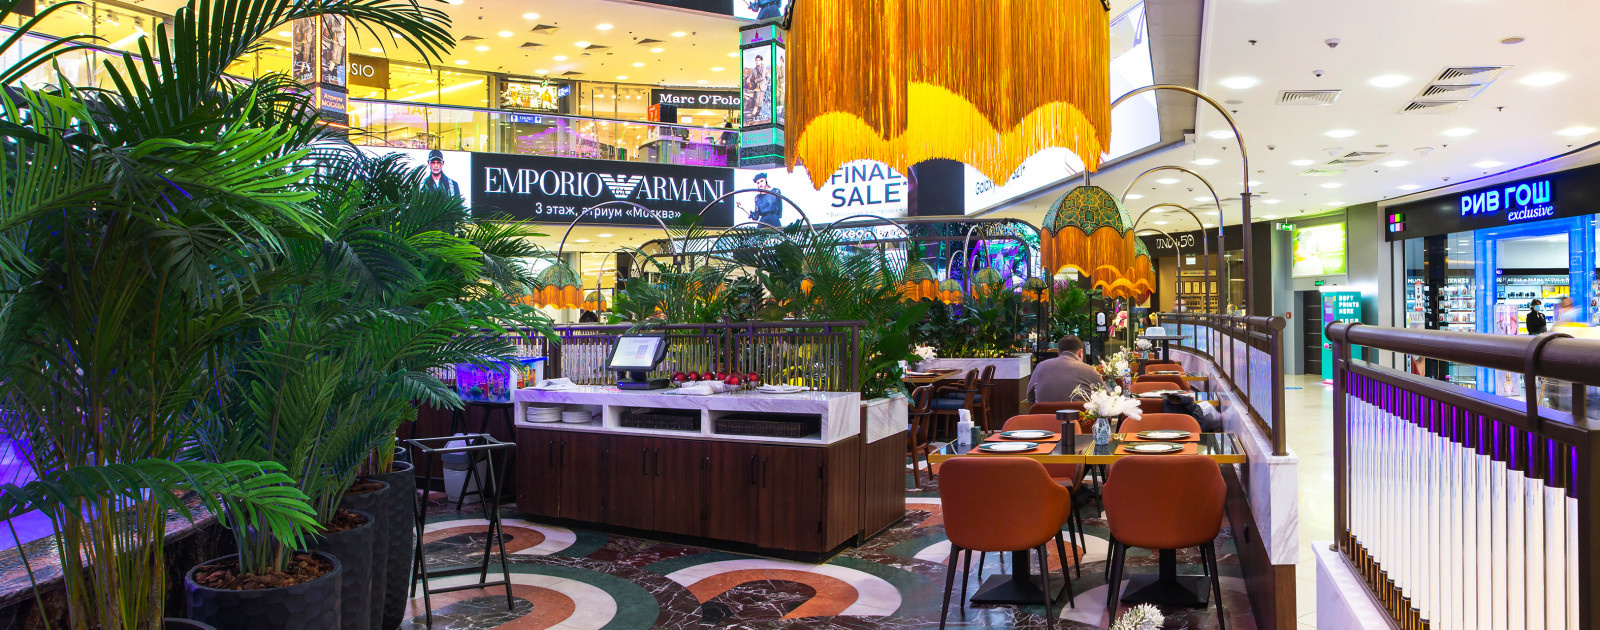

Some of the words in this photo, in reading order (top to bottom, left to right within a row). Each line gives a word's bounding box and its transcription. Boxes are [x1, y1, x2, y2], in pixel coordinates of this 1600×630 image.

[659, 93, 696, 104] Marc
[698, 94, 741, 105] O'Polo
[484, 167, 604, 198] EMPORIO
[636, 174, 725, 203] ARMANI
[1461, 190, 1500, 216] РИВ
[1504, 181, 1551, 209] ГОШ
[535, 202, 543, 214] 3
[546, 205, 578, 218] этаж,
[1508, 205, 1554, 222] exclusive
